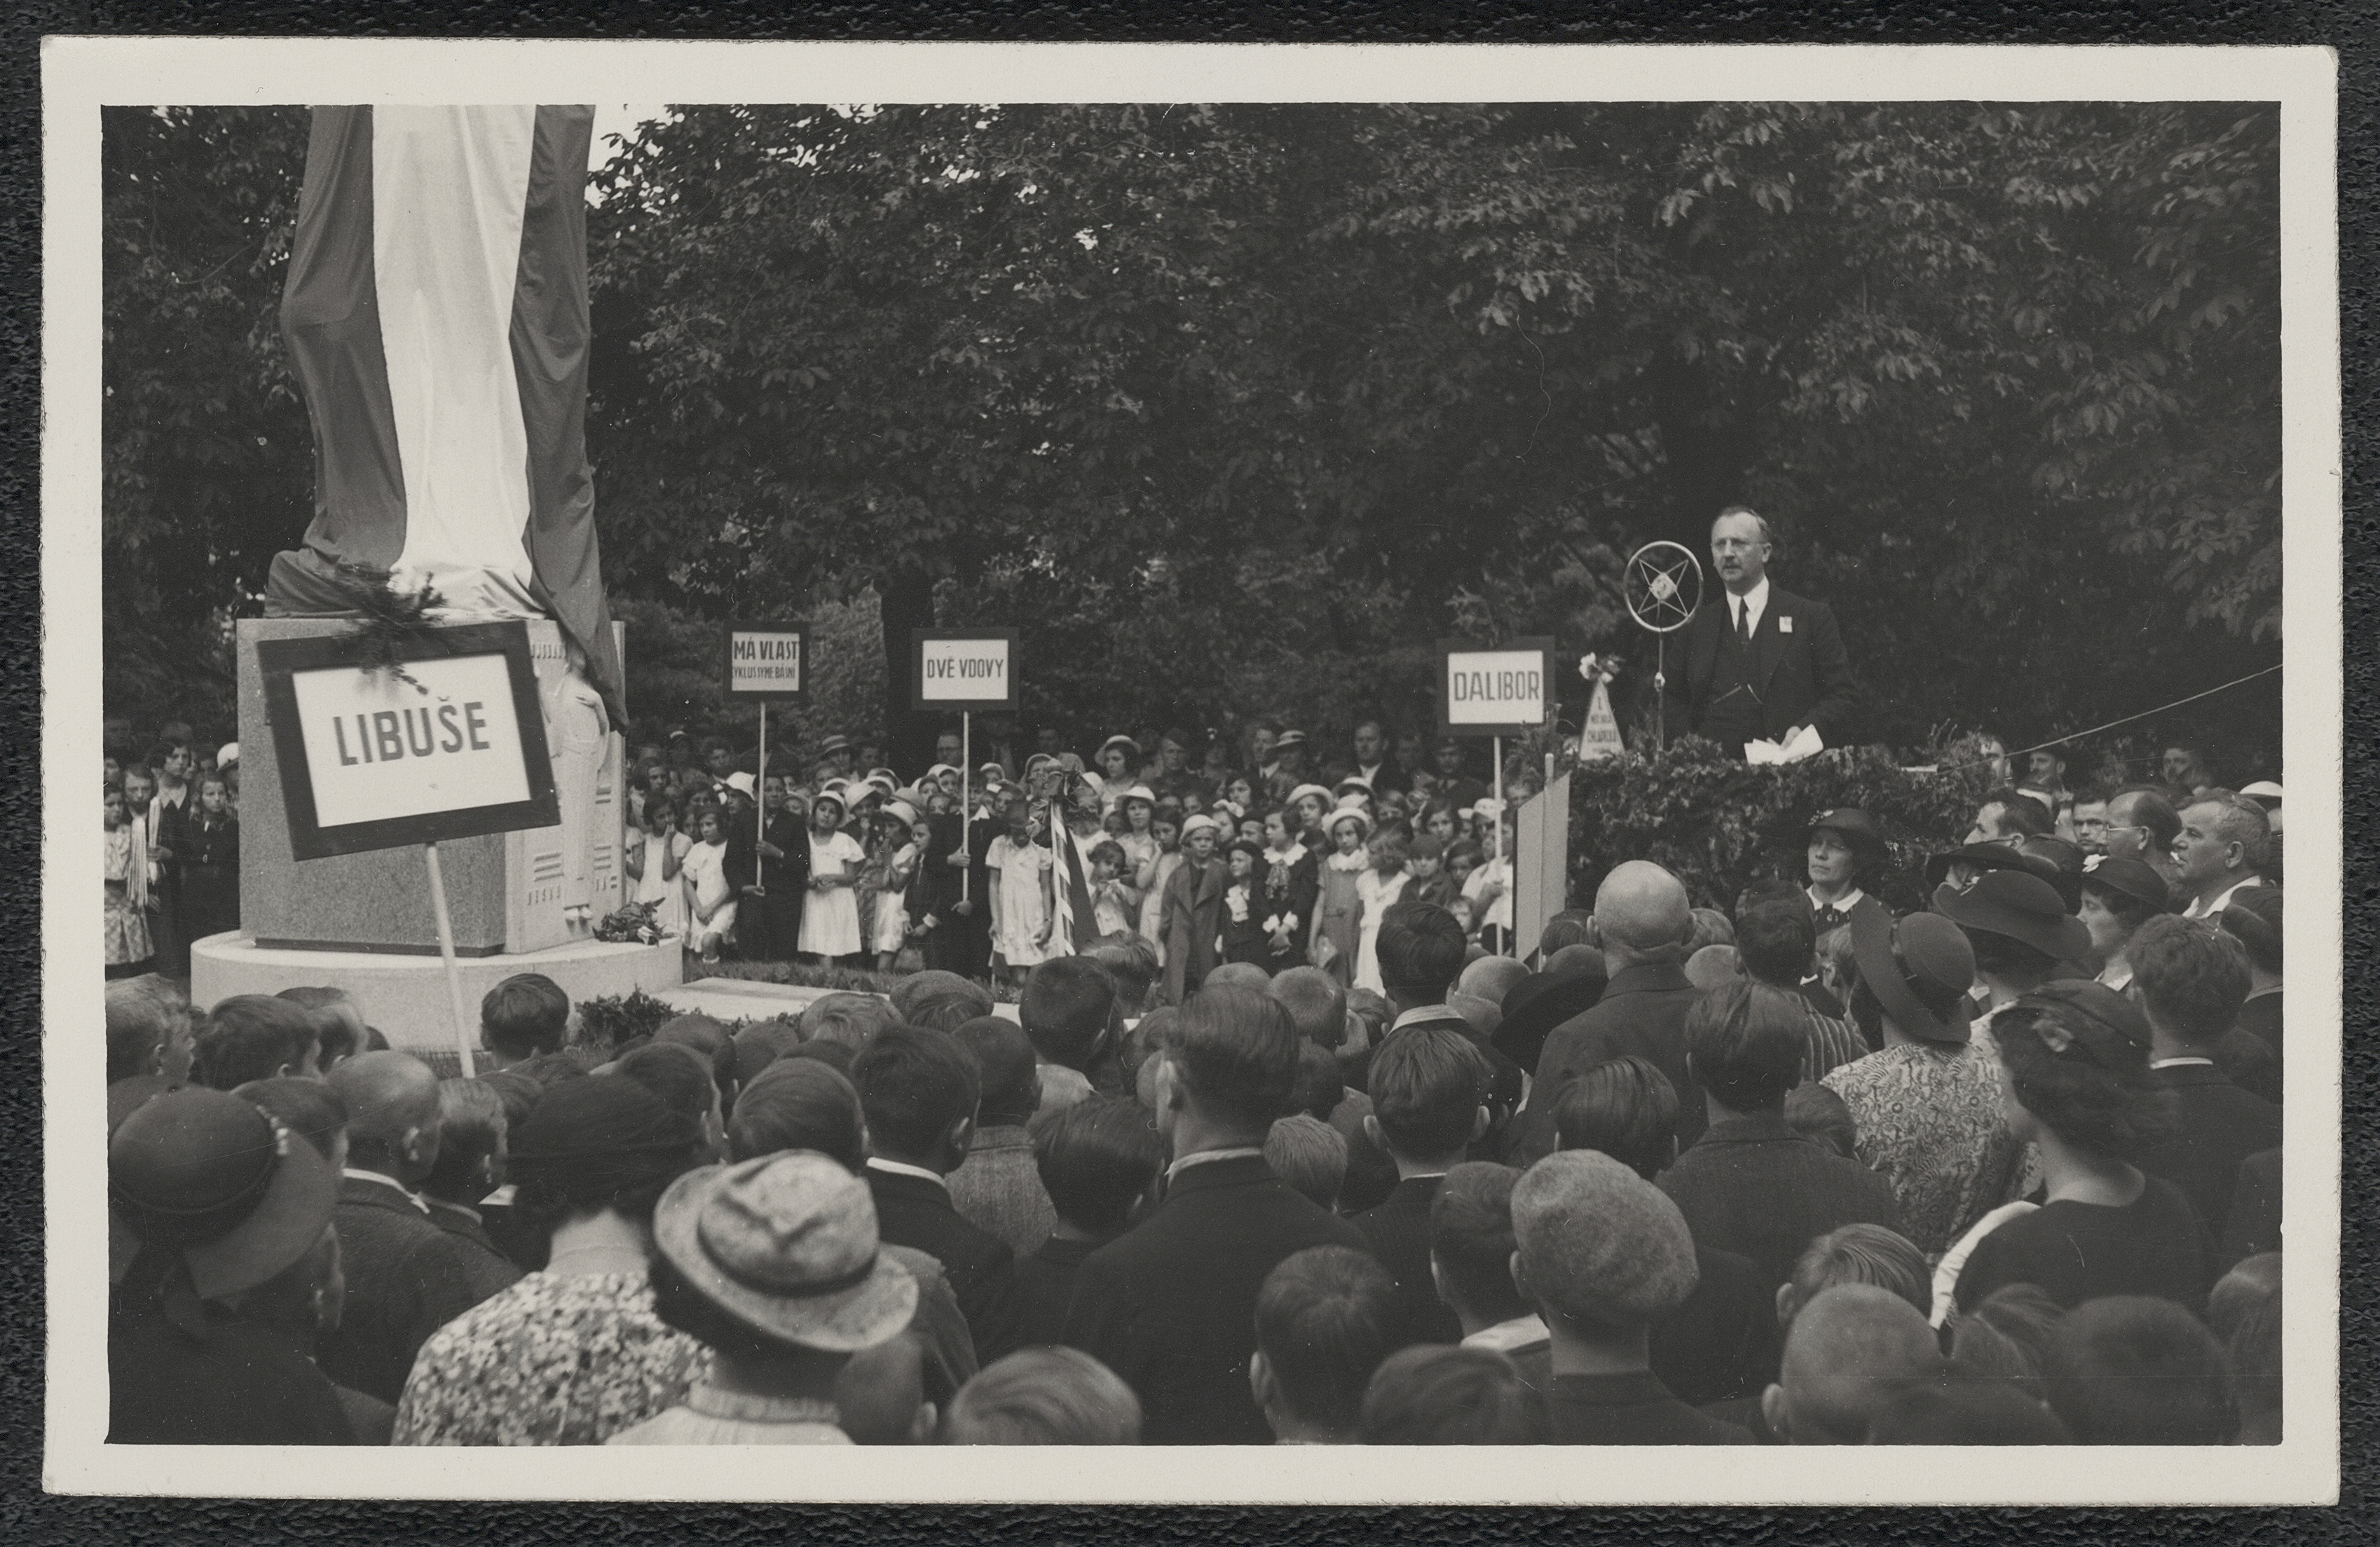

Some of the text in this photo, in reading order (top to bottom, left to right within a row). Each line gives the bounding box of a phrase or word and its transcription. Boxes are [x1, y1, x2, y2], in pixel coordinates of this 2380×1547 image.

[734, 636, 798, 660] MÁ VLAST
[926, 655, 1004, 678] DVĚ VDOVY
[1454, 671, 1540, 701] DALIBOR
[331, 695, 491, 766] LIBUŠE
